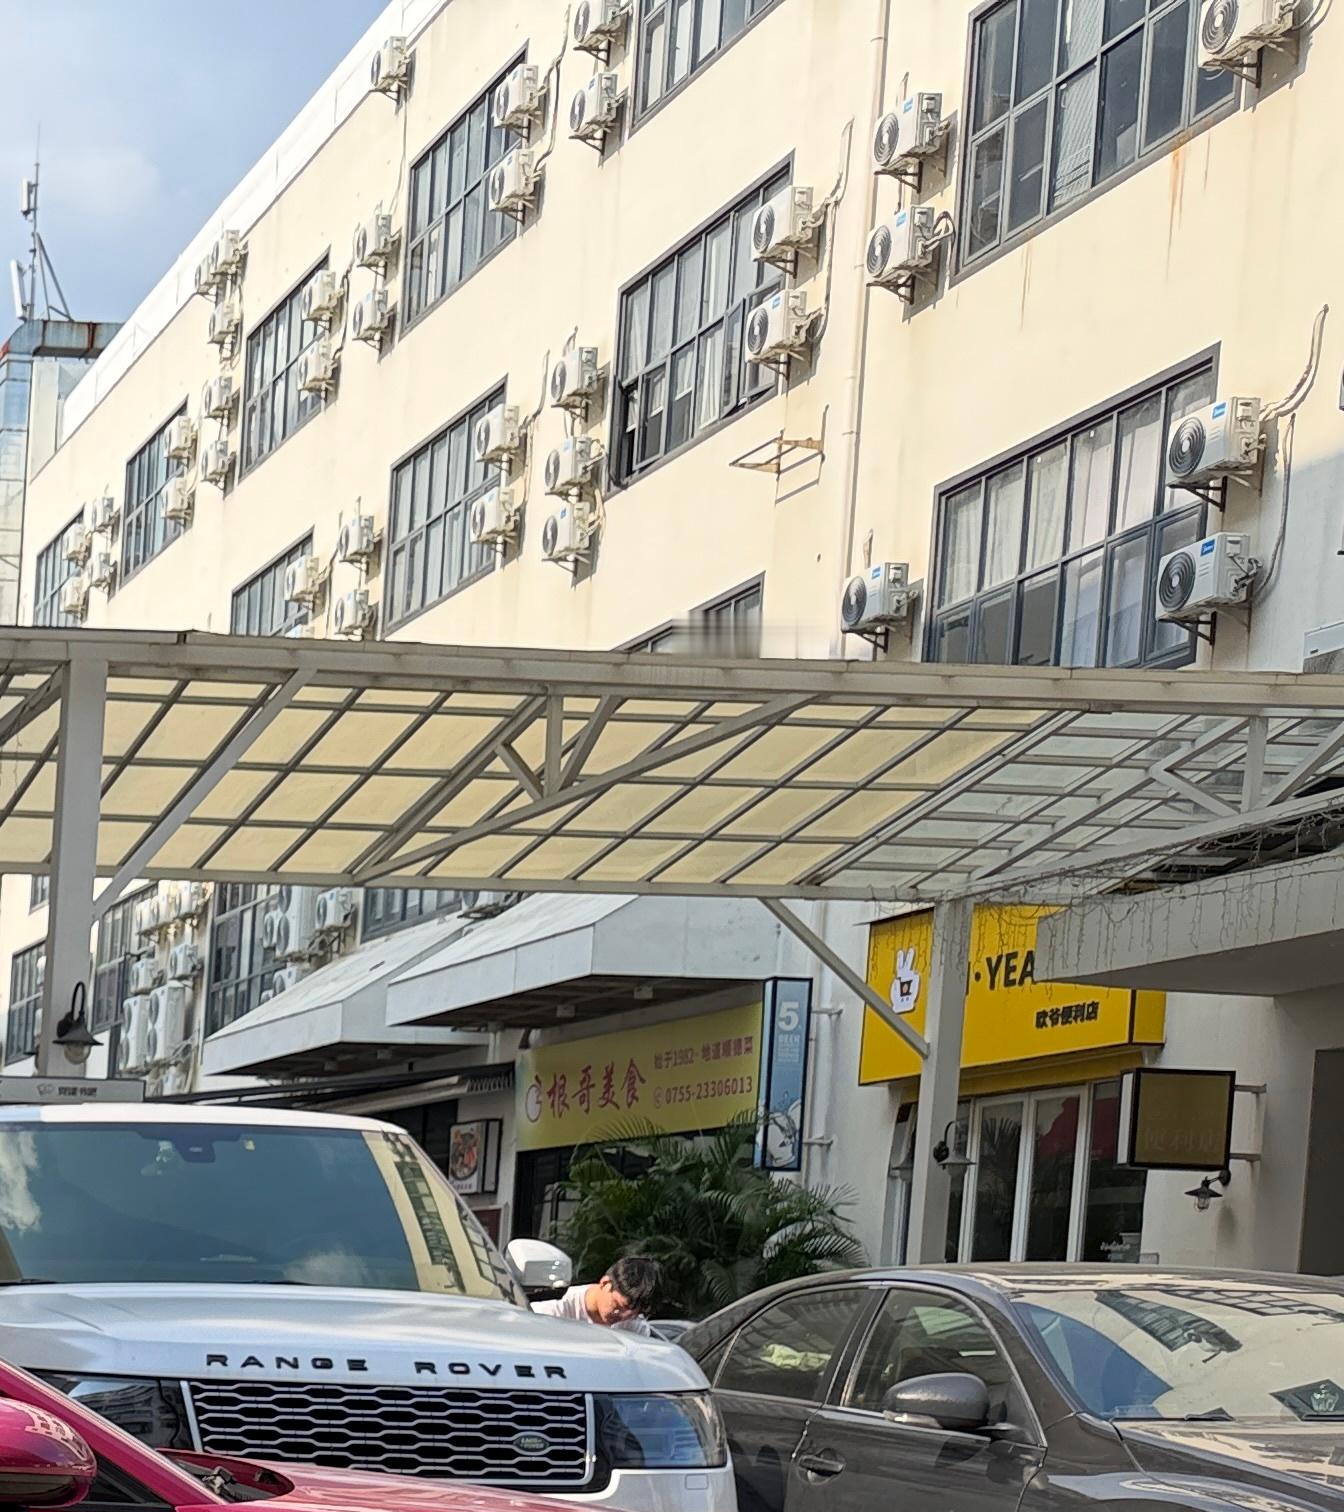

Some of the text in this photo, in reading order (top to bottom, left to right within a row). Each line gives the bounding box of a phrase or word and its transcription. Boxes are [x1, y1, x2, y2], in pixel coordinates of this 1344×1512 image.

[778, 1001, 800, 1032] 5
[546, 1057, 647, 1119] 根哥美食
[206, 1353, 568, 1380] RANGE ROVER
